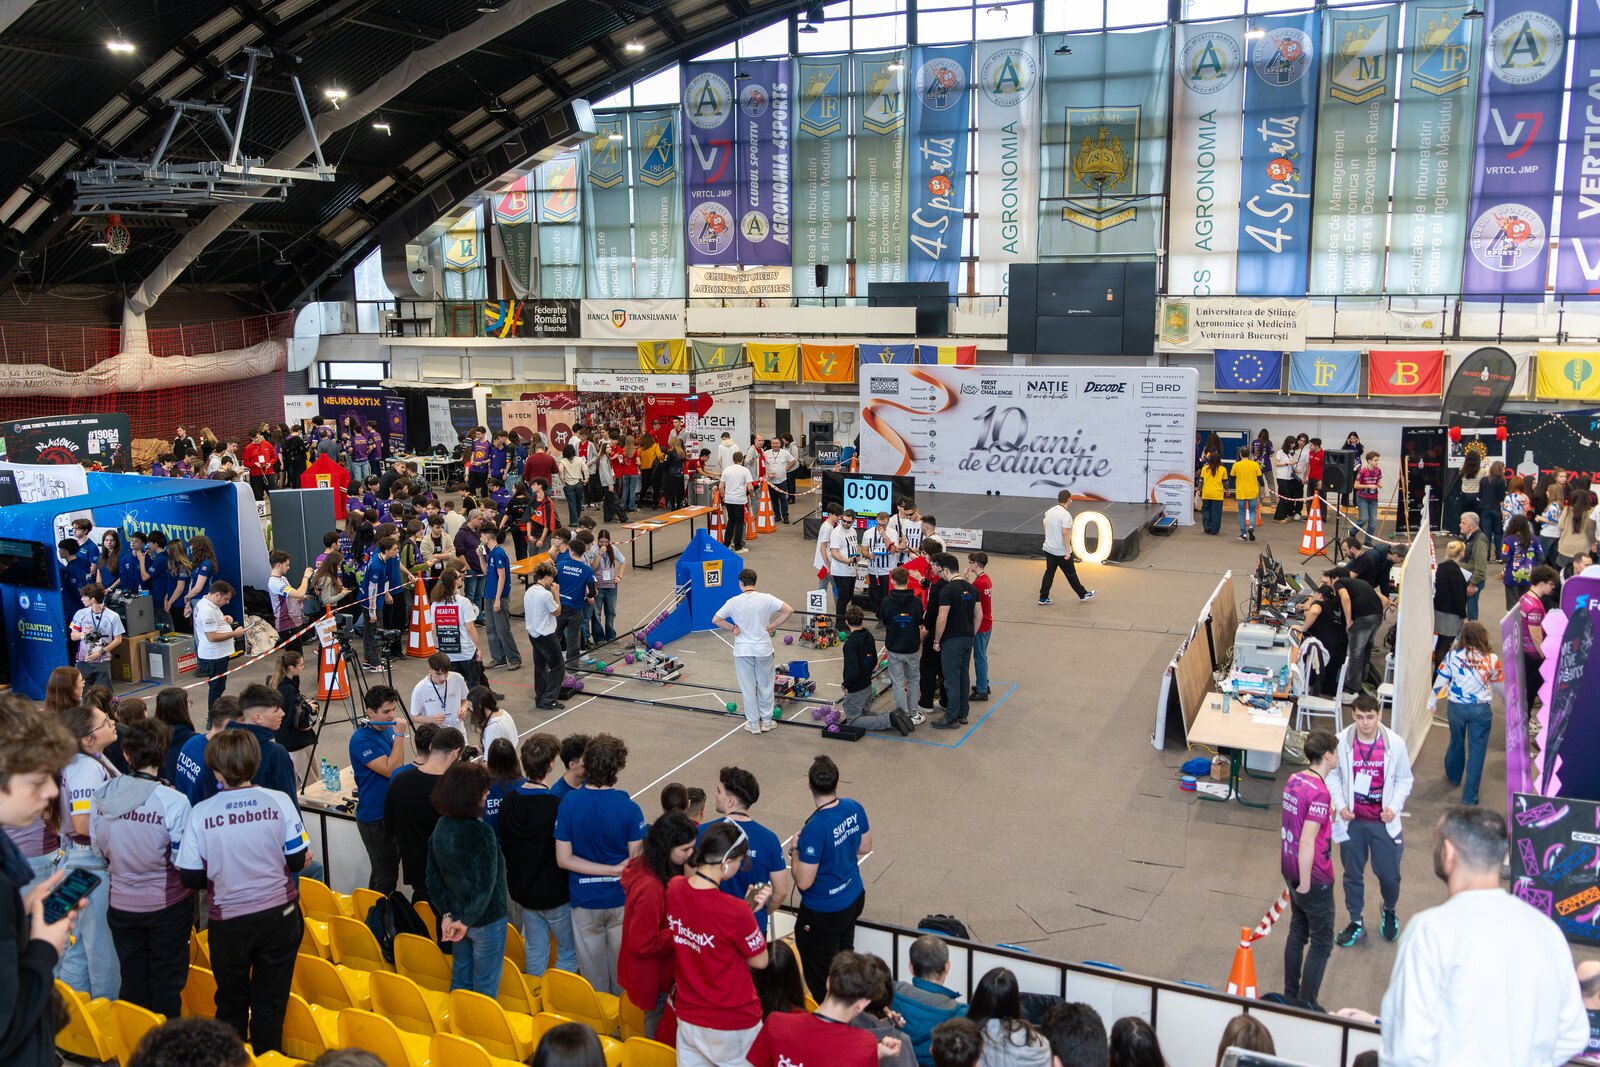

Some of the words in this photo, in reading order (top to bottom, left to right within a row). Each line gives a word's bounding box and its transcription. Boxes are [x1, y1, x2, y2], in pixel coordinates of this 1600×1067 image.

[771, 82, 788, 151] 4SPORTS
[1366, 101, 1381, 149] Rurala
[1436, 98, 1453, 157] Mediului
[750, 121, 760, 169] SPORTIV
[1414, 119, 1432, 200] Imbunatatiri
[1001, 120, 1018, 255] AGRONOMIA
[1195, 109, 1217, 252] AGRONOMIA
[1328, 130, 1345, 211] Management
[1362, 153, 1376, 213] Dezvoltare
[1432, 160, 1448, 213] Ingineria
[1485, 167, 1517, 175] VRTCL
[1518, 165, 1539, 174] JMP
[691, 190, 715, 198] VRTCL
[772, 154, 789, 247] AGRONOMIA
[807, 157, 818, 225] Imbunatatiri
[867, 157, 879, 228] Management
[1343, 170, 1360, 240] Economica
[821, 188, 833, 236] Ingineria
[879, 197, 890, 248] Economica
[1328, 214, 1340, 231] de
[1416, 206, 1425, 223] de
[1344, 242, 1354, 293] nginerie
[1407, 227, 1424, 295] Facultatea
[534, 314, 567, 324] Română
[587, 313, 609, 321] BANCA
[628, 313, 677, 321] TRANSILVANIA
[1193, 319, 1245, 329] Agronomice
[1256, 320, 1297, 329] Medicină
[1196, 307, 1252, 316] Universitatea
[1255, 308, 1266, 316] de
[1201, 331, 1245, 340] Veterinară
[1156, 384, 1181, 392] BRD
[1394, 361, 1420, 386] B
[323, 396, 381, 407] NEUROBOTIX
[88, 429, 119, 440] #19064
[958, 452, 982, 471] de
[847, 482, 889, 501] 0:00
[18, 620, 53, 633] QUANTUM
[177, 751, 201, 776] TUDOR
[204, 815, 224, 830] ILC
[228, 807, 279, 825] Robotix
